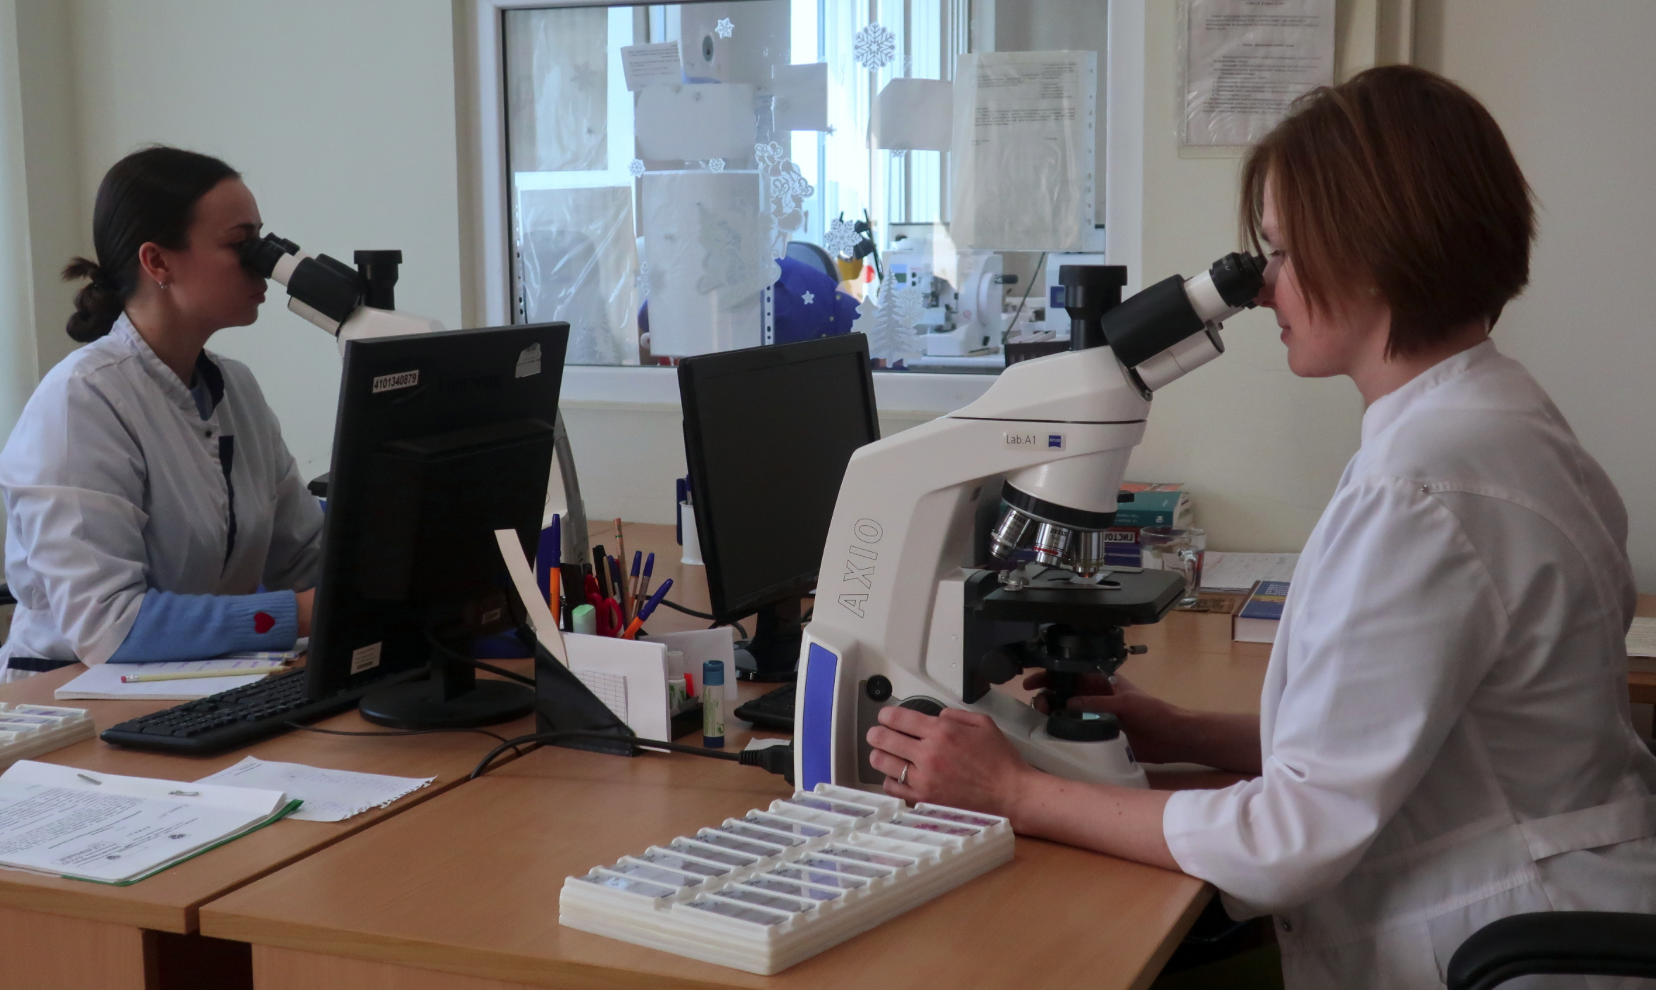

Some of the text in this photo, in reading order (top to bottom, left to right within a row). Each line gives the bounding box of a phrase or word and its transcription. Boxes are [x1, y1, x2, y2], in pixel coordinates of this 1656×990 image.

[373, 372, 417, 389] 4101340879
[1006, 434, 1036, 446] Lab.A1
[837, 517, 884, 619] AXIO
